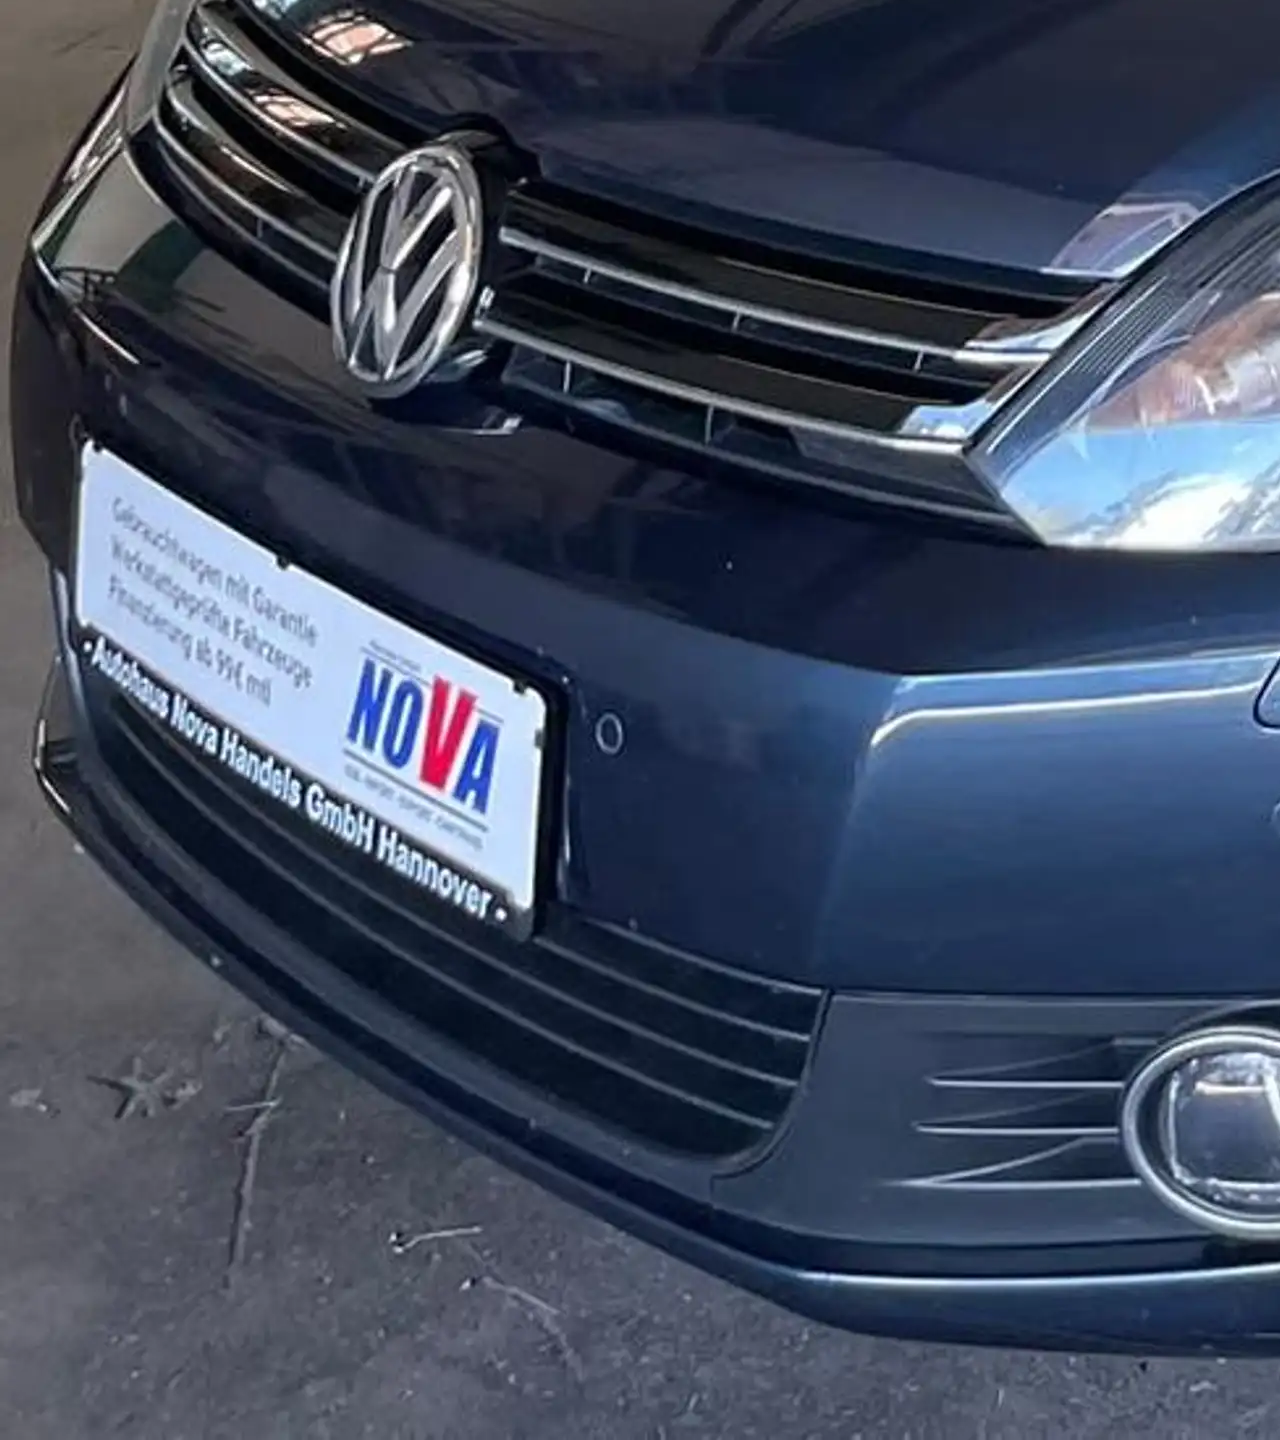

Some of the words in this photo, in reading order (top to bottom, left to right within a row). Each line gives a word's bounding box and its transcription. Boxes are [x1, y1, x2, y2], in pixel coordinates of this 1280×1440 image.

[108, 573, 194, 662] Finanzierung
[195, 635, 213, 668] ab
[225, 572, 250, 607] mit
[252, 586, 318, 648] Garantie
[232, 616, 314, 689] Fahrzeuge
[91, 635, 170, 720] Autohaus
[170, 691, 217, 757] Nova
[219, 726, 301, 809] Handels
[305, 781, 375, 853] GmbH
[376, 823, 494, 920] Hannover
[346, 656, 501, 815] NOVA
